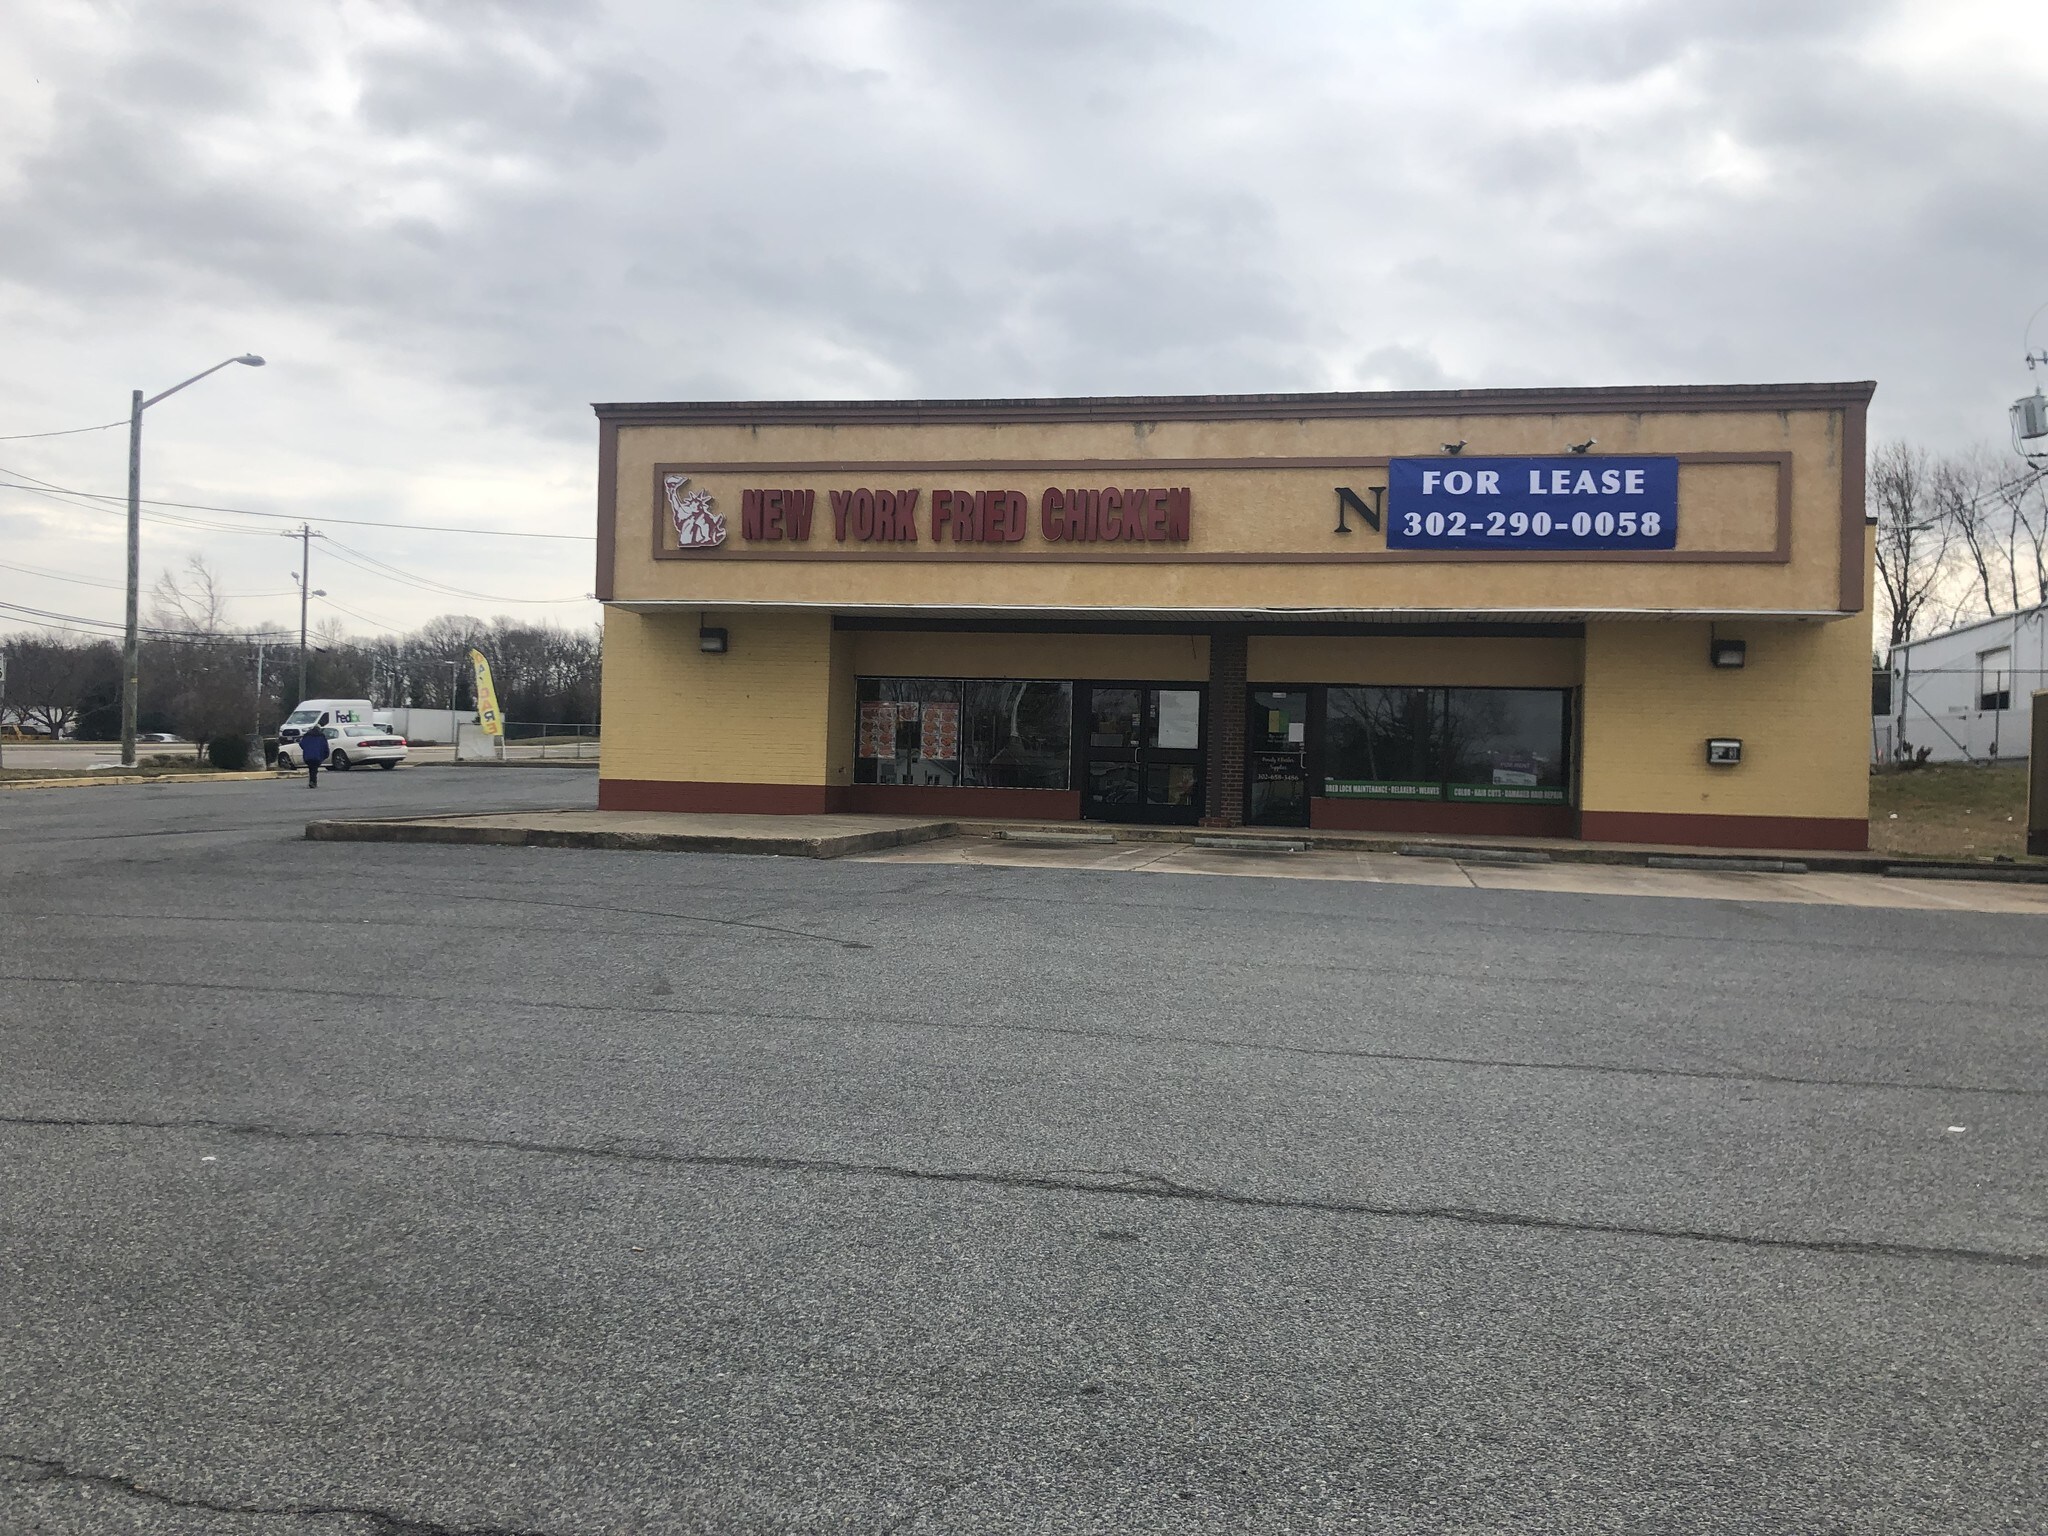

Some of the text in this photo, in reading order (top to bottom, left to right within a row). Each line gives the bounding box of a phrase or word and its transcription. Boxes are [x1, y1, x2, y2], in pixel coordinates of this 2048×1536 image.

[1421, 469, 1646, 496] FOR LEASE
[741, 486, 1191, 543] NEW YORK FRIED CHICKEN
[1402, 511, 1662, 538] 302-290-0058
[335, 710, 361, 723] FedEx
[1339, 784, 1352, 793] LOCK
[1353, 785, 1387, 794] MAINTENANCE
[1419, 786, 1440, 795] WEAVES
[1454, 788, 1471, 796] COLOR
[1488, 789, 1501, 797] CUTS
